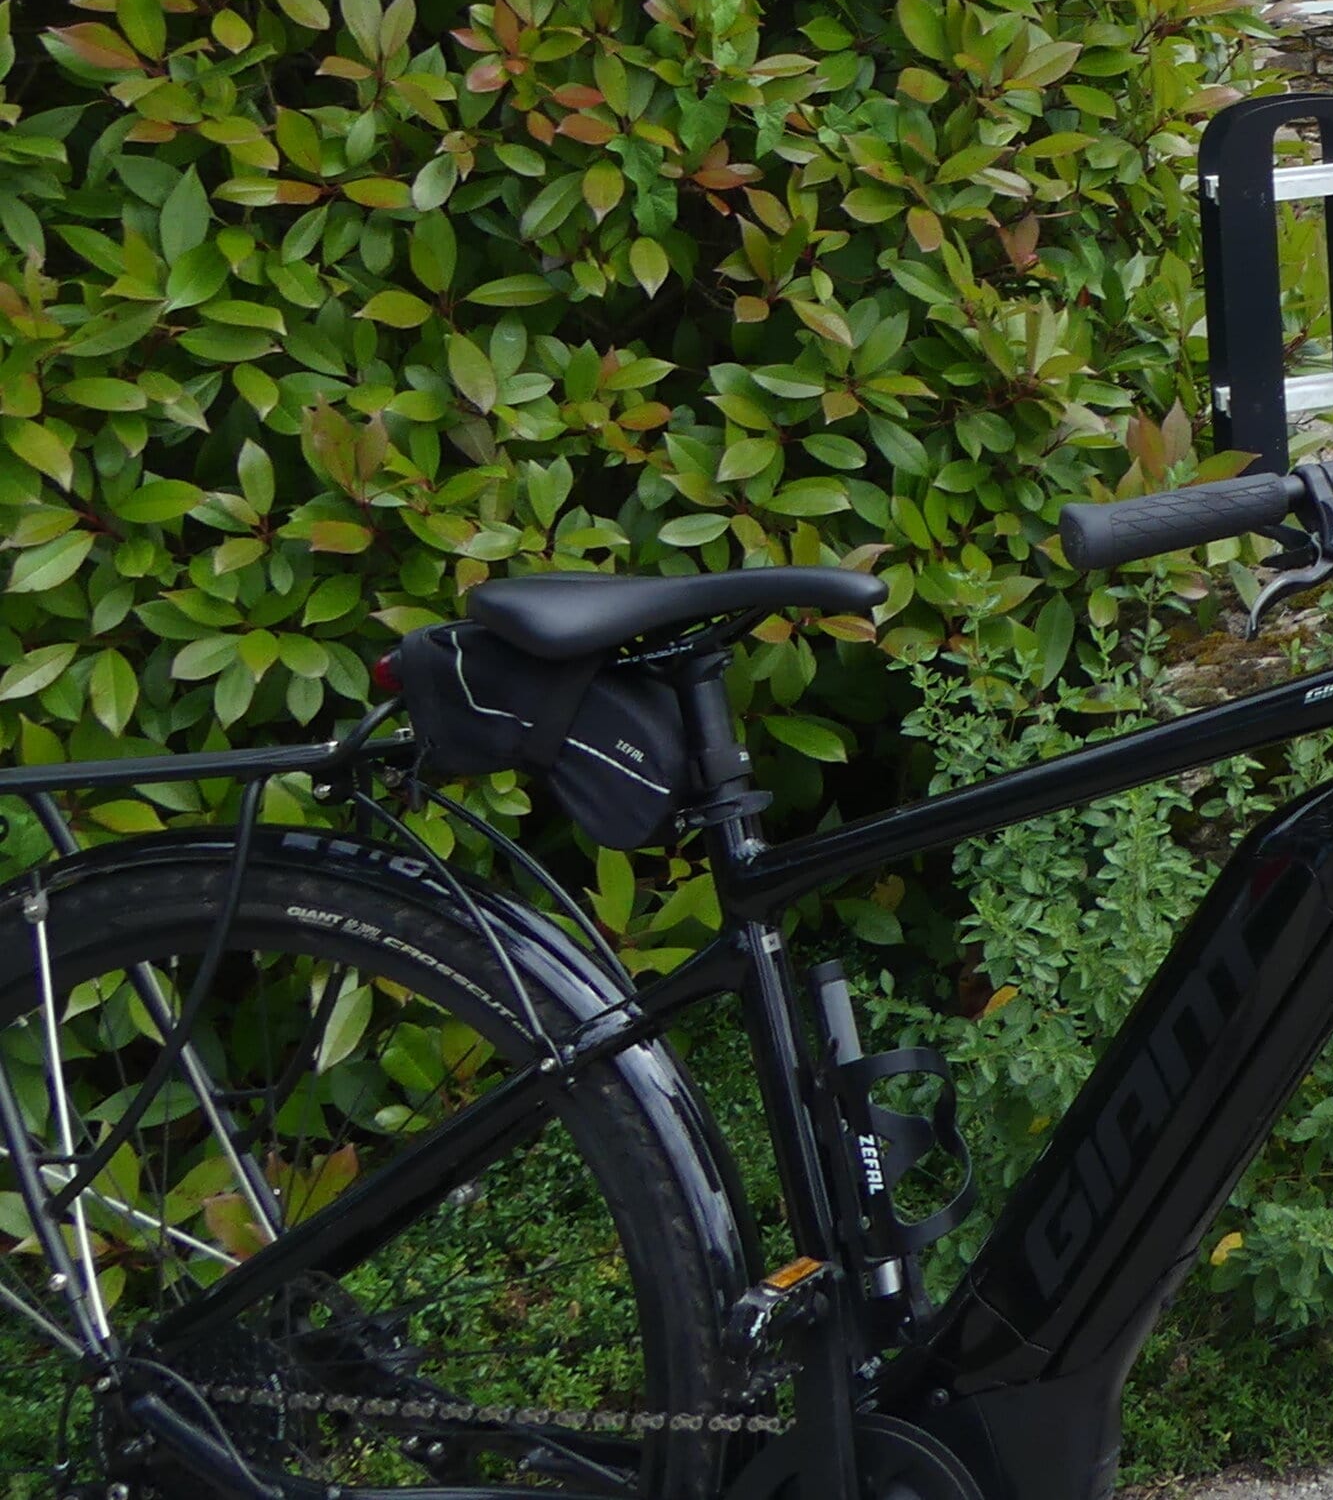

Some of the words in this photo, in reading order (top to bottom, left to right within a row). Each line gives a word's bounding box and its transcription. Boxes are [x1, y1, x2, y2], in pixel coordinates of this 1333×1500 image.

[615, 739, 645, 763] ZEFAL
[287, 906, 343, 924] GIANT
[858, 1134, 886, 1196] ZEFAL
